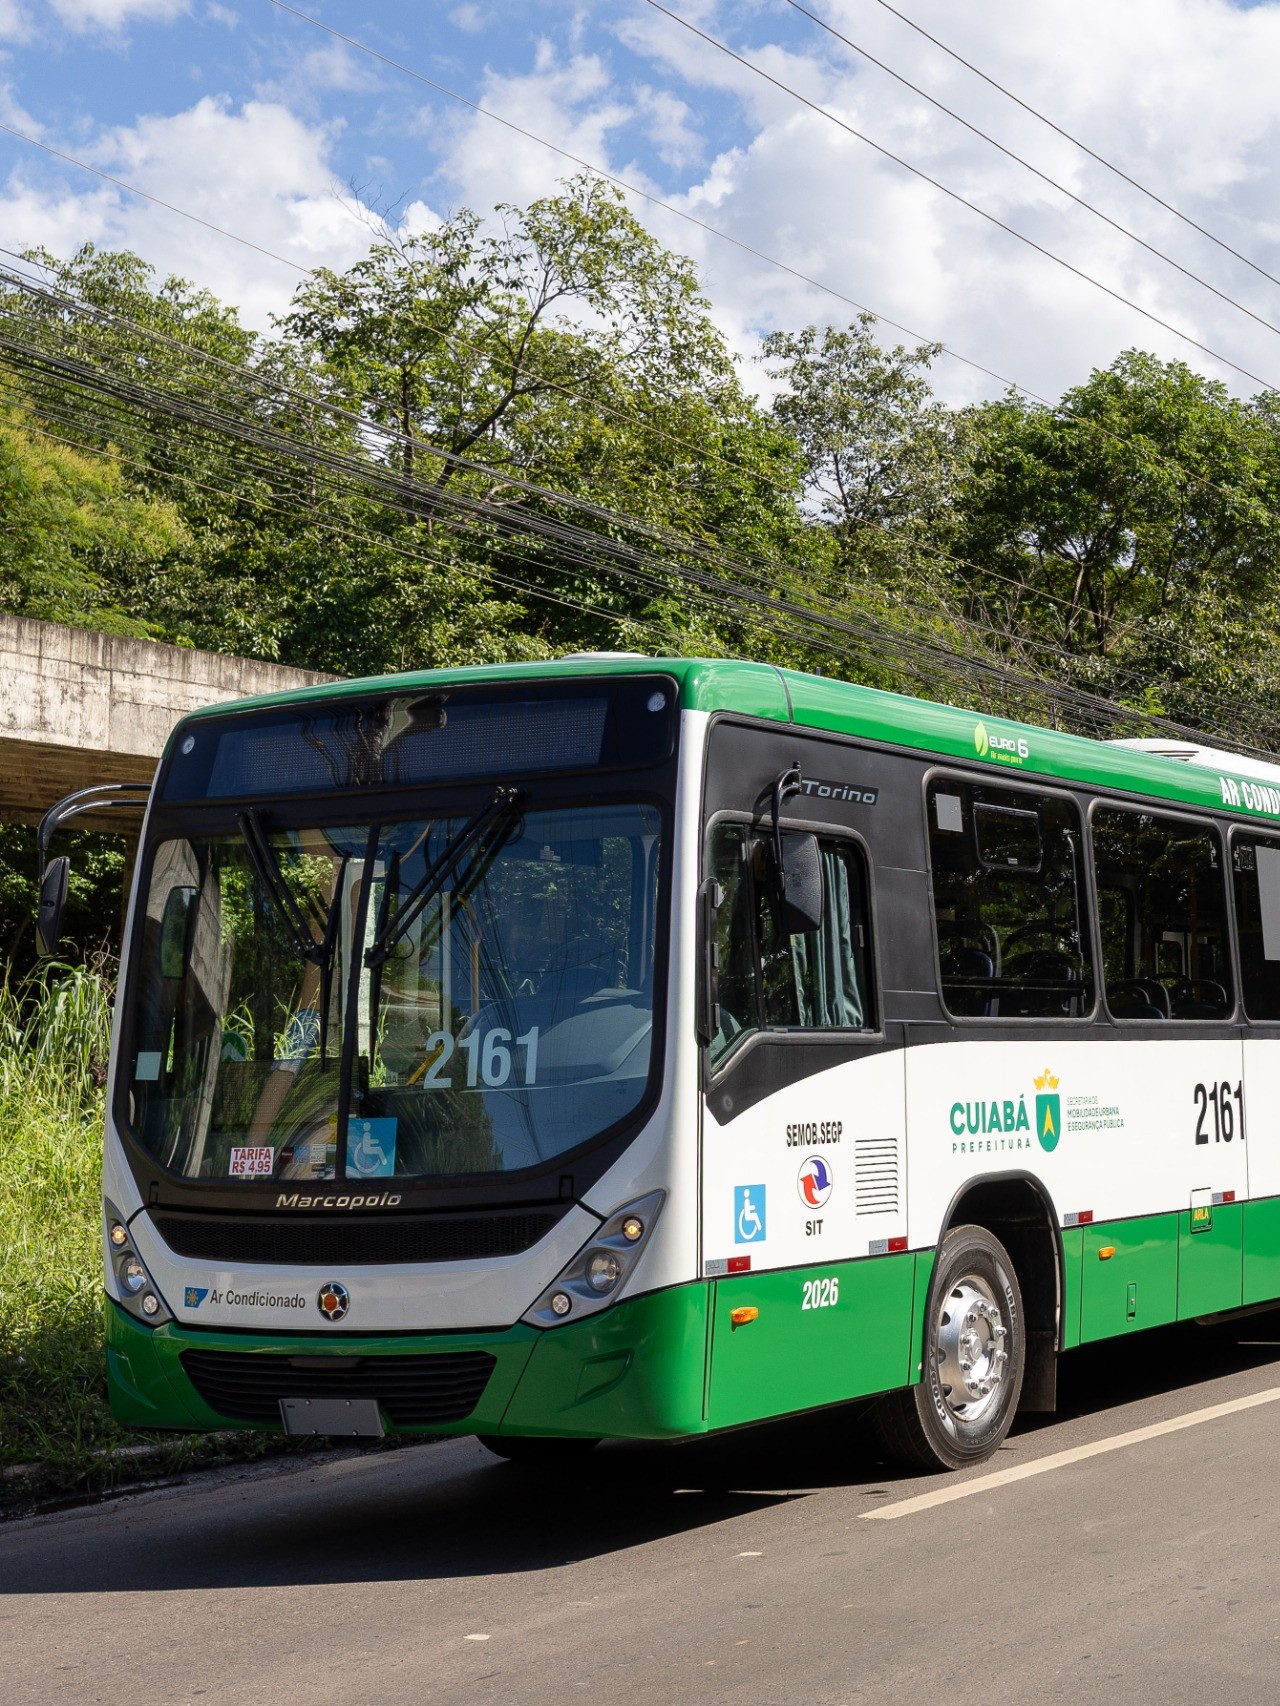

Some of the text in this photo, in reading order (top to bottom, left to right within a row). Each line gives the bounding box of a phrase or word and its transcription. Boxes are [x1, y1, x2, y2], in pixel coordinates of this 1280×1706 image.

[989, 736, 1028, 758] EURO 6
[802, 780, 876, 804] Torino
[1219, 776, 1241, 806] AR
[423, 1026, 539, 1089] 2161
[950, 1094, 1030, 1135] CUIABÁ
[1194, 1080, 1244, 1145] 2161
[786, 1121, 843, 1147] SEMOB.SEGP
[233, 1148, 271, 1160] TARIFA
[952, 1138, 1031, 1154] PREFEITURA
[232, 1160, 271, 1174] R$ 4,95
[276, 1191, 402, 1210] Marcopolo
[1194, 1207, 1209, 1221] ARLA
[805, 1219, 824, 1236] SIT
[210, 1289, 306, 1309] Ar Condicionado
[801, 1277, 839, 1310] 2026
